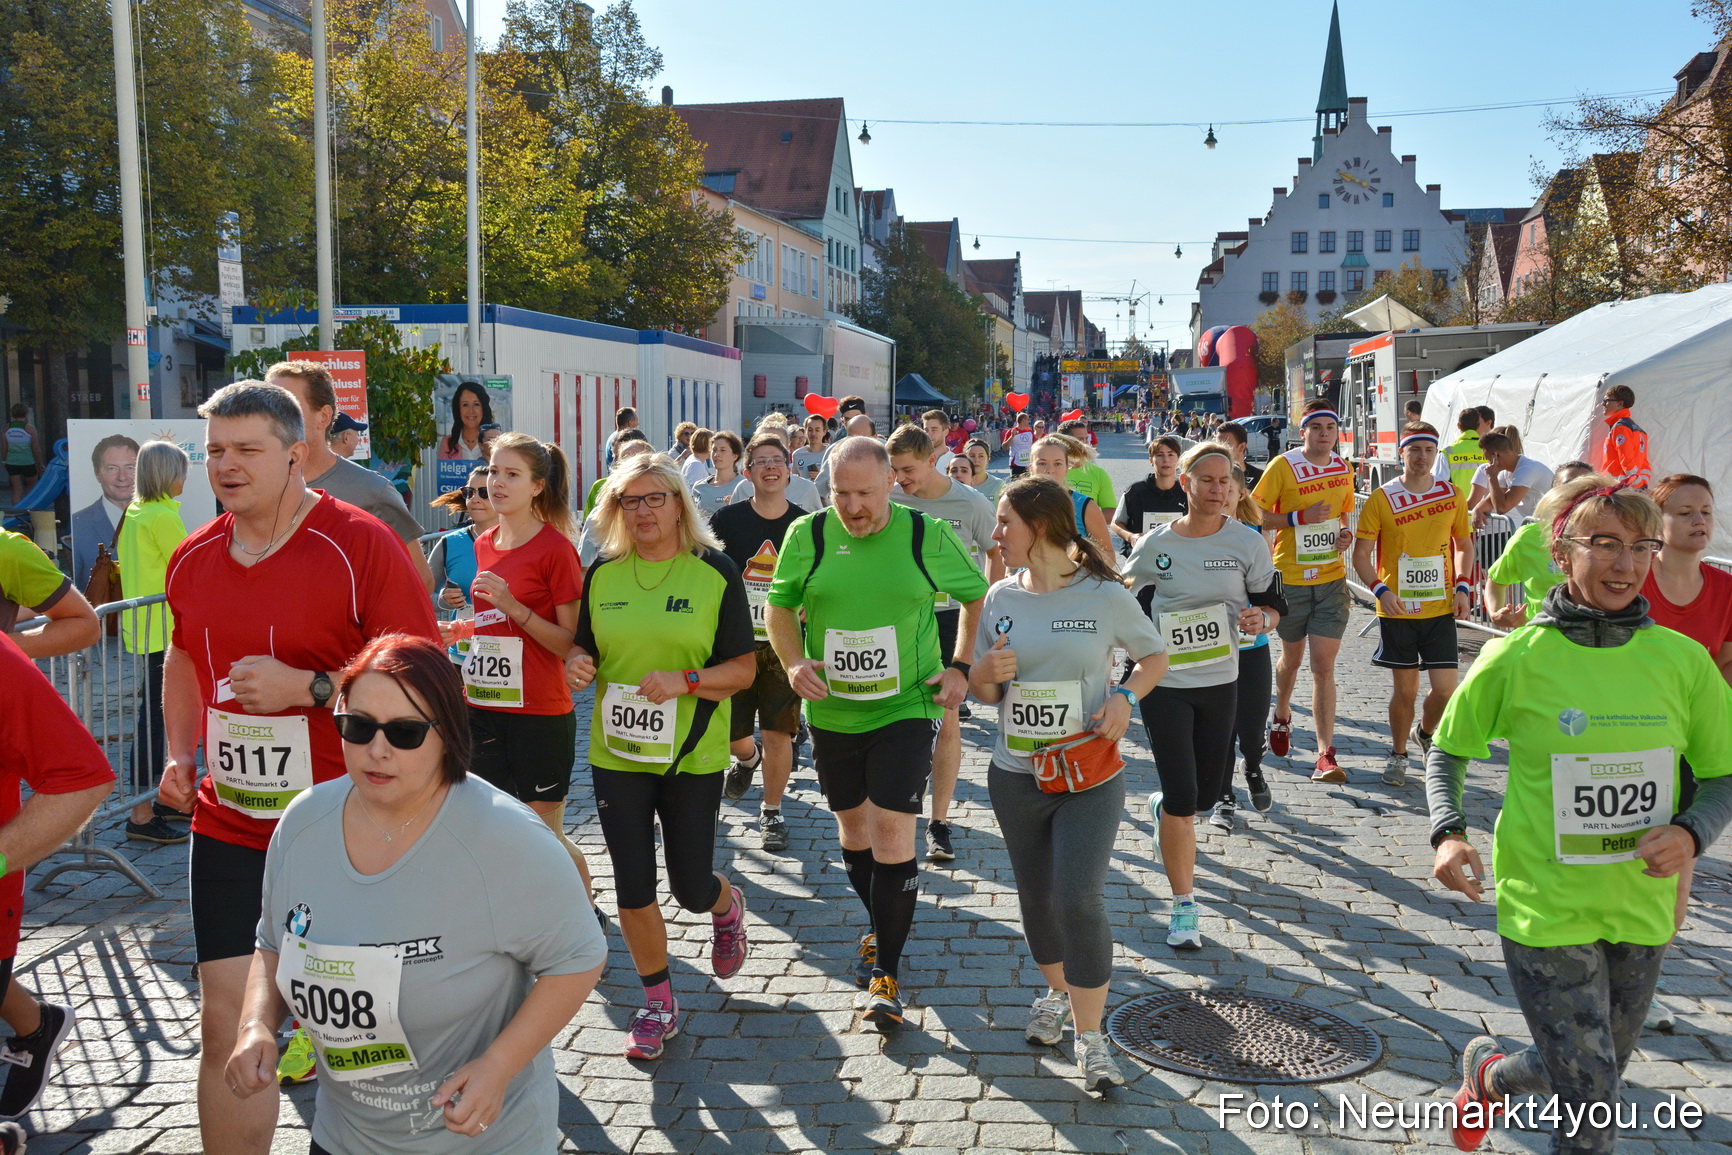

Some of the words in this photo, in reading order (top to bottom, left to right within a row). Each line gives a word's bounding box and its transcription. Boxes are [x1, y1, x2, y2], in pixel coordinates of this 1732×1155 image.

[165, 355, 173, 371] 3
[1086, 362, 1113, 370] START
[332, 378, 361, 389] hluss!
[71, 393, 102, 402] STREB
[141, 384, 150, 400] FC
[1453, 454, 1488, 462] Org.-Lei
[440, 461, 467, 475] Helga
[440, 485, 457, 493] CSU
[1298, 482, 1326, 496] MAX
[1327, 477, 1349, 489] BÖGL
[1394, 510, 1424, 527] MAX
[1427, 500, 1457, 517] BÖGL
[1303, 531, 1336, 548] 5090
[1203, 559, 1239, 569] BOCK
[1405, 568, 1439, 584] 5089
[1051, 619, 1097, 630] BOCK
[843, 635, 875, 646] BOCK
[1171, 621, 1220, 646] 5199
[468, 655, 512, 678] 5126
[834, 648, 888, 672] 5062
[475, 688, 501, 699] Estelle
[848, 683, 878, 693] Hubert
[1020, 689, 1057, 698] BOCK
[622, 691, 648, 702] BOC
[612, 704, 664, 733] 5046
[1012, 703, 1069, 728] 5057
[228, 722, 275, 738] BOCK
[1018, 728, 1034, 736] PARTL
[627, 742, 641, 754] Ute
[218, 740, 292, 776] 5117
[1590, 761, 1644, 776] BOCK
[226, 776, 245, 786] PARTL
[245, 779, 278, 788] Neumarkt
[234, 791, 279, 807] Werner
[1573, 780, 1657, 818] 5029
[1583, 822, 1609, 830] PARTL
[1611, 819, 1642, 829] Neumarkt
[1602, 836, 1636, 851] Petra
[304, 954, 355, 977] BOCK
[413, 954, 444, 965] concepts
[290, 978, 377, 1030] 5098
[323, 1033, 363, 1043] Neumarkt
[349, 1079, 438, 1096] Neumarkter
[351, 1090, 420, 1112] Stadtlauf
